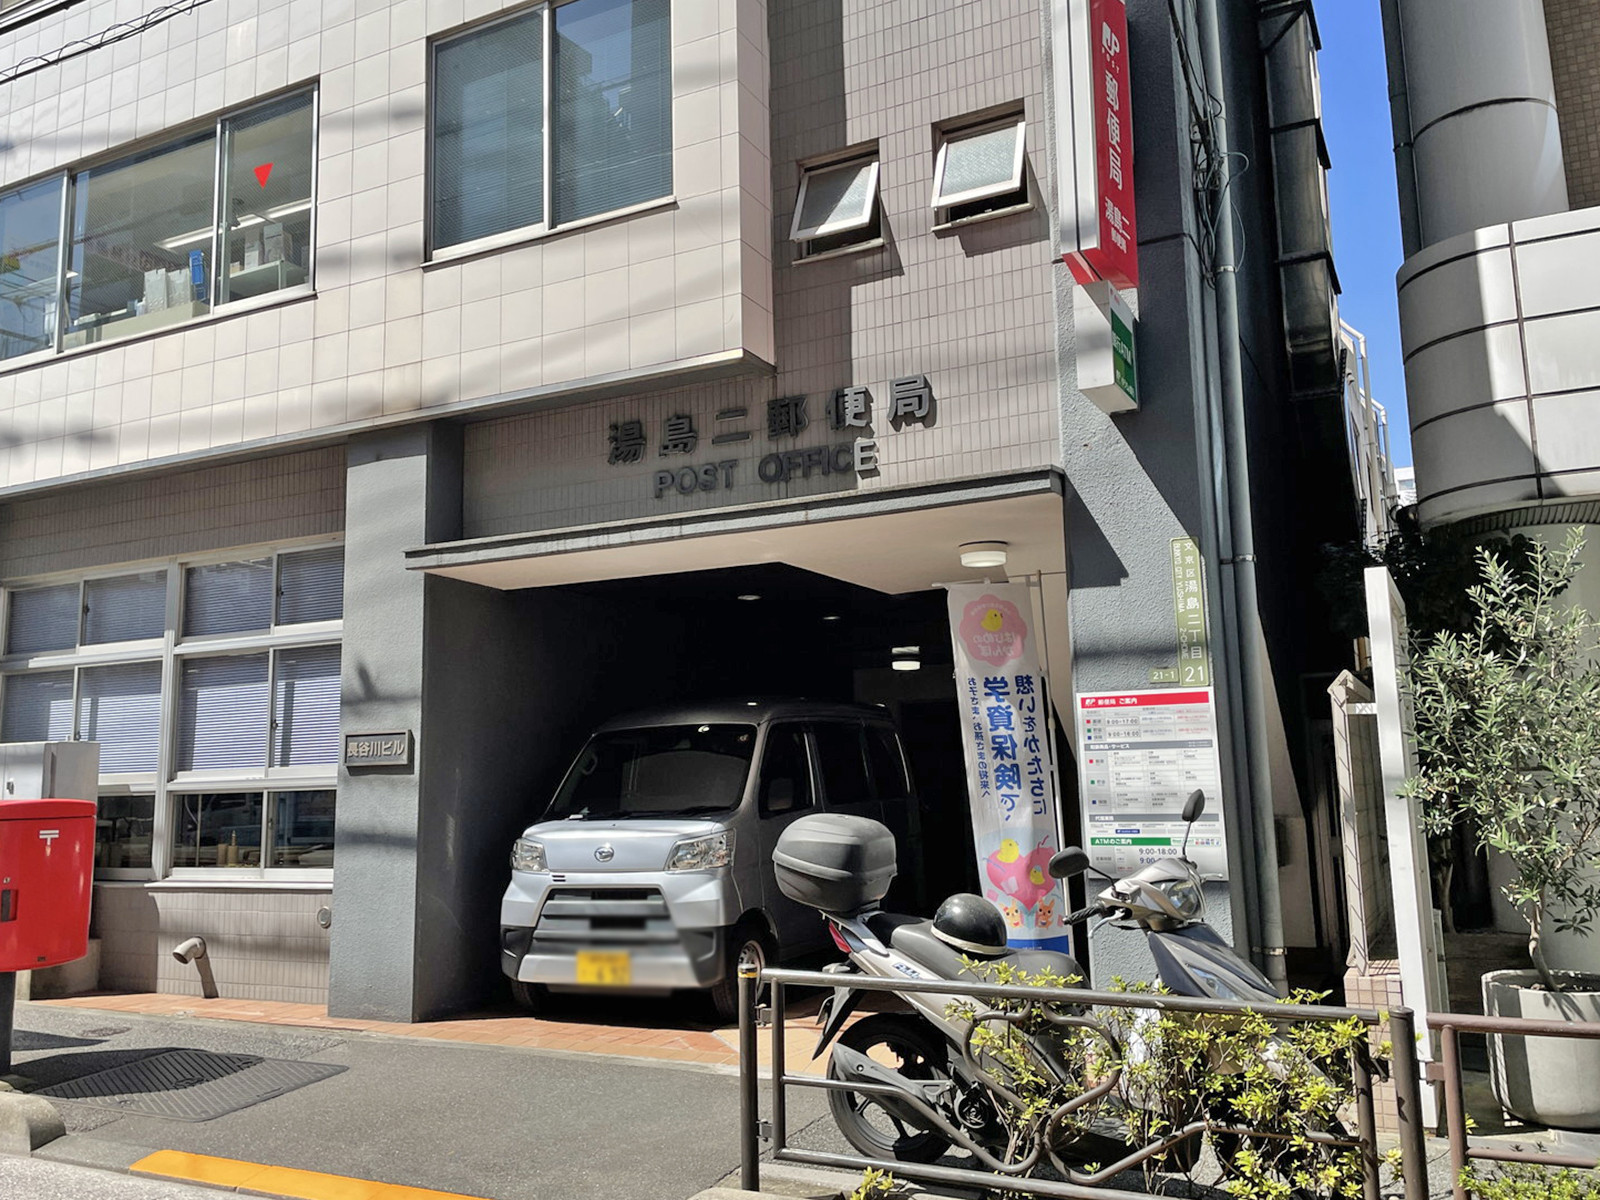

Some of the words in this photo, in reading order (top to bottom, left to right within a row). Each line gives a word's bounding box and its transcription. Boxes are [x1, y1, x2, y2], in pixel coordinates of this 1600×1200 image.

[1104, 69, 1123, 192] 郵便局
[607, 374, 931, 465] 湯島二郵便局
[653, 459, 739, 499] POST
[758, 438, 880, 484] OFFICE
[1176, 580, 1186, 614] YUSHIMA
[1179, 627, 1189, 661] 2-CHOME
[1152, 670, 1175, 682] 21-1
[1184, 665, 1205, 683] 21
[347, 740, 405, 758] 長谷川ビル
[1138, 848, 1178, 856] 9:00-18:00
